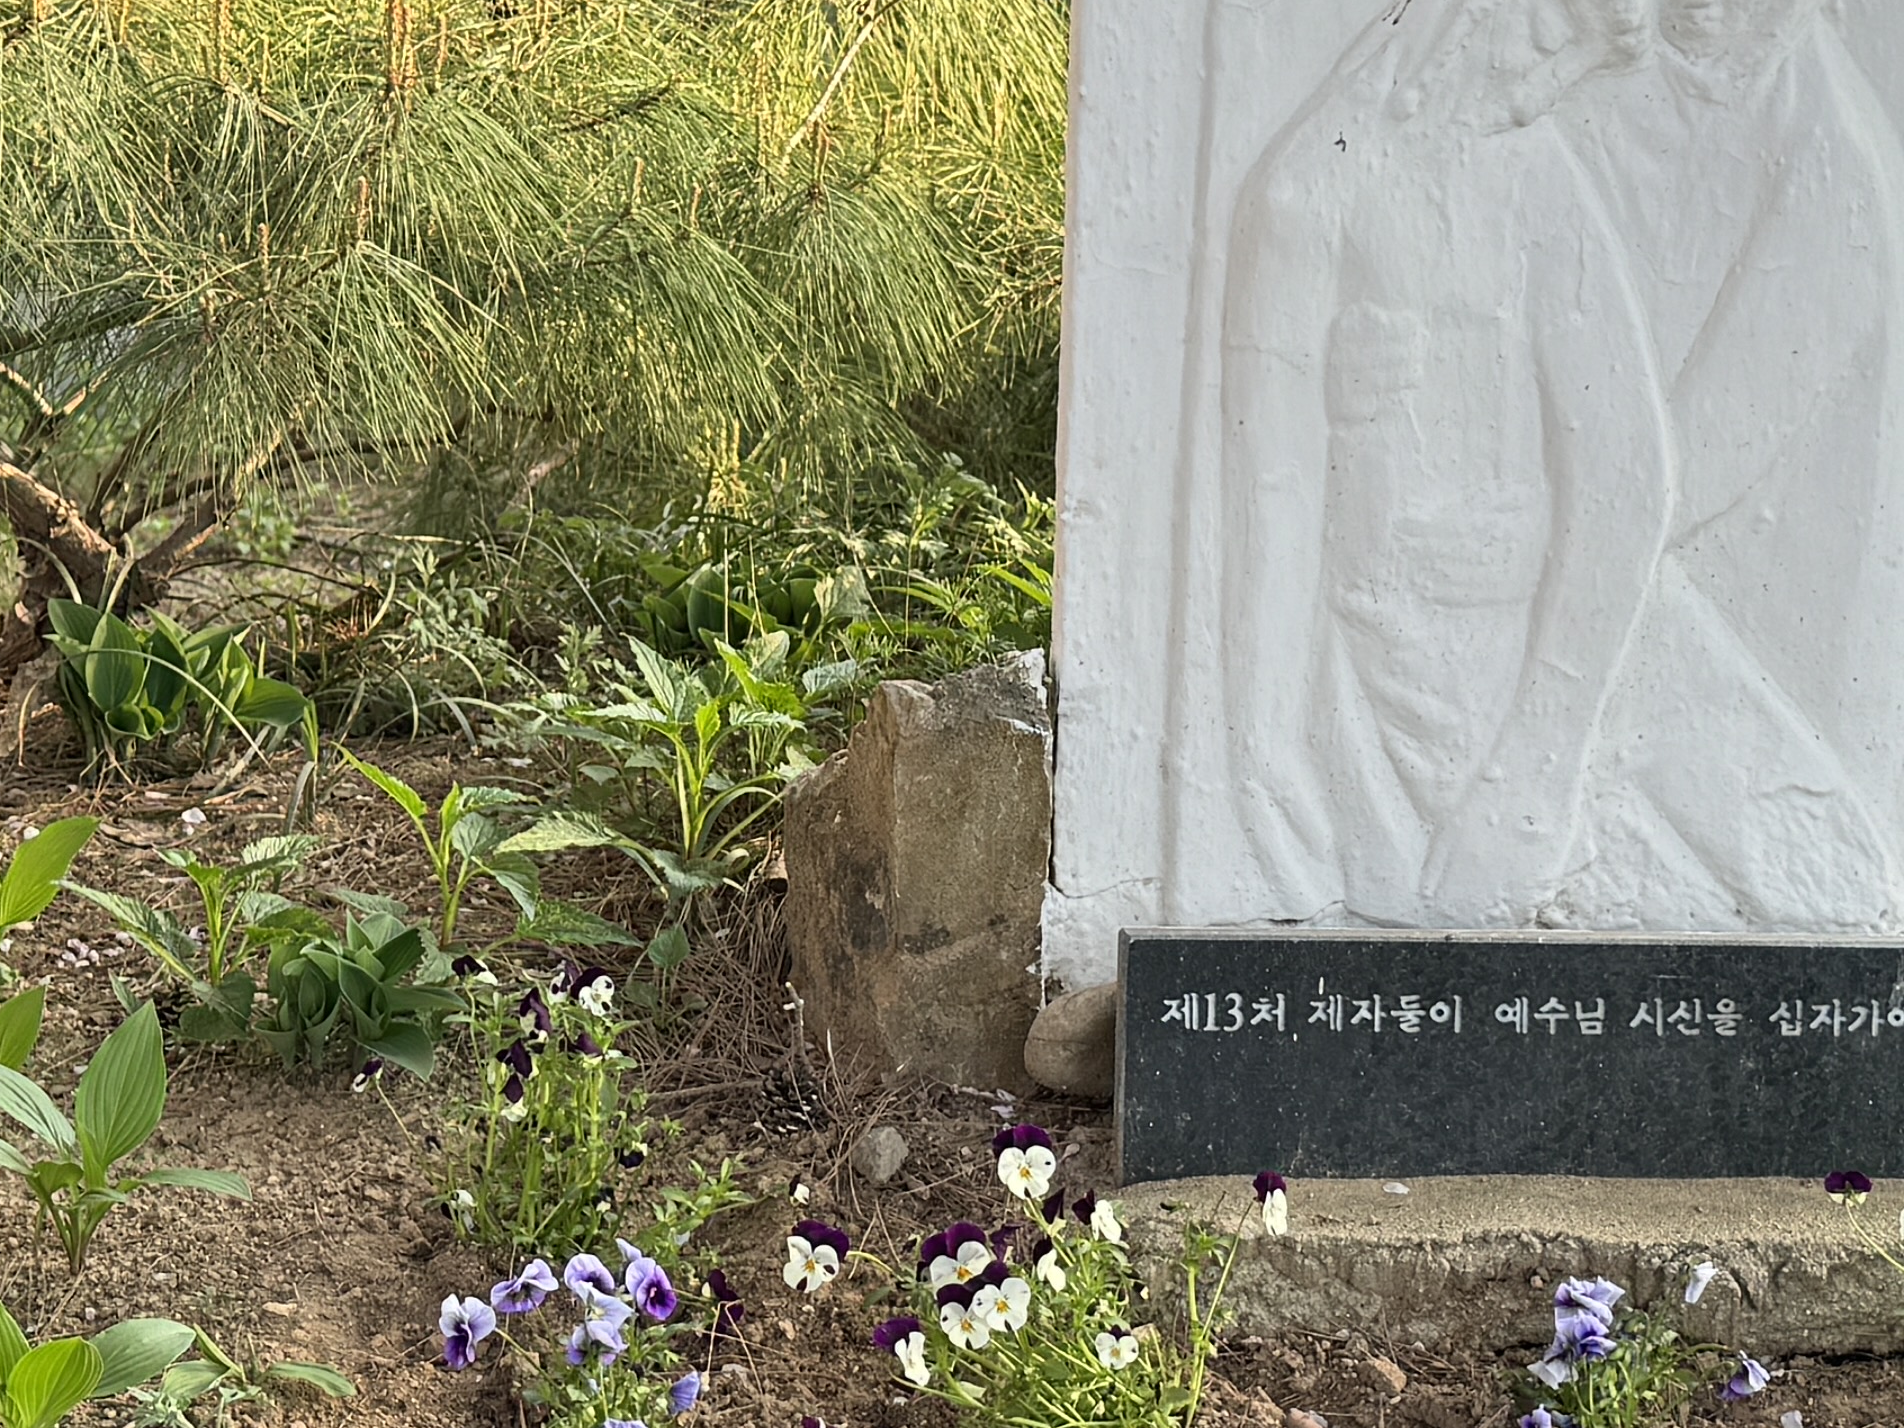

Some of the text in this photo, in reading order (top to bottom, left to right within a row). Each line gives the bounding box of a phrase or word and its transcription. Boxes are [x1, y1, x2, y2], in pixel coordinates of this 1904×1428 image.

[1160, 992, 1287, 1033] 제13처
[1495, 995, 1606, 1037] 예수님
[1629, 997, 1744, 1038] 시신을
